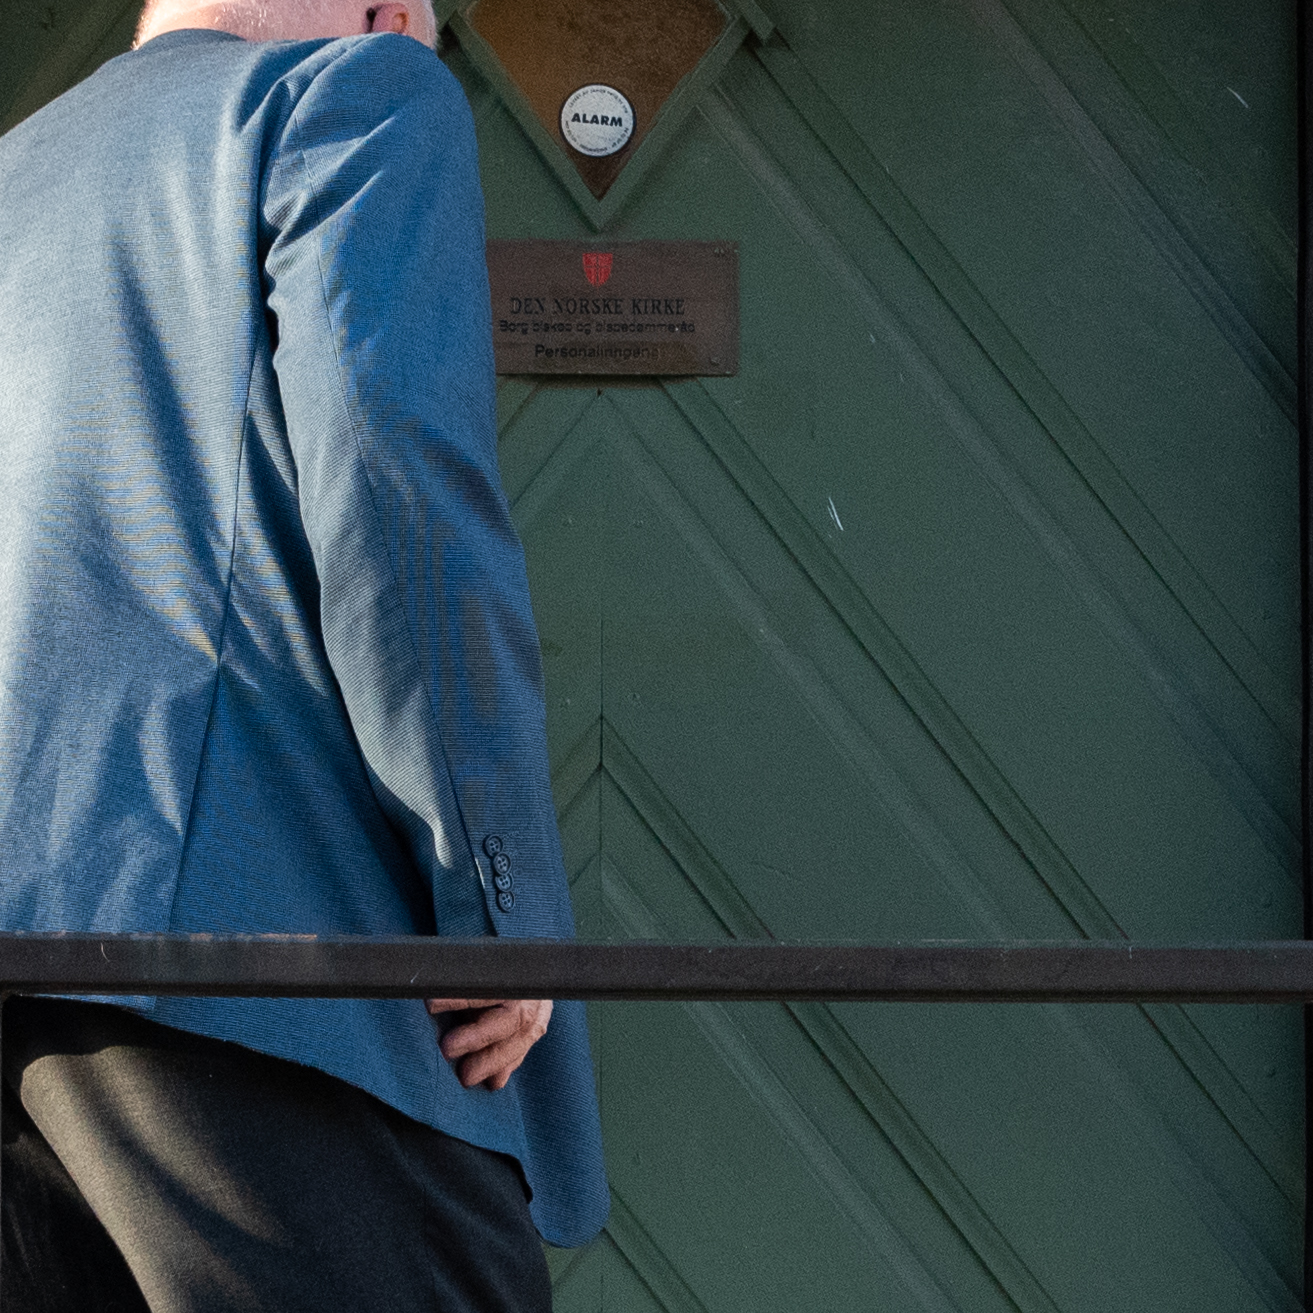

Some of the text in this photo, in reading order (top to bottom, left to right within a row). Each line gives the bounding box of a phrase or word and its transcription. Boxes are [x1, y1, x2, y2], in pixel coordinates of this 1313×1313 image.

[571, 112, 623, 127] ALARM
[510, 297, 686, 316] DEN NORSKE KIRKE
[499, 319, 529, 335] Borg
[576, 322, 592, 335] og
